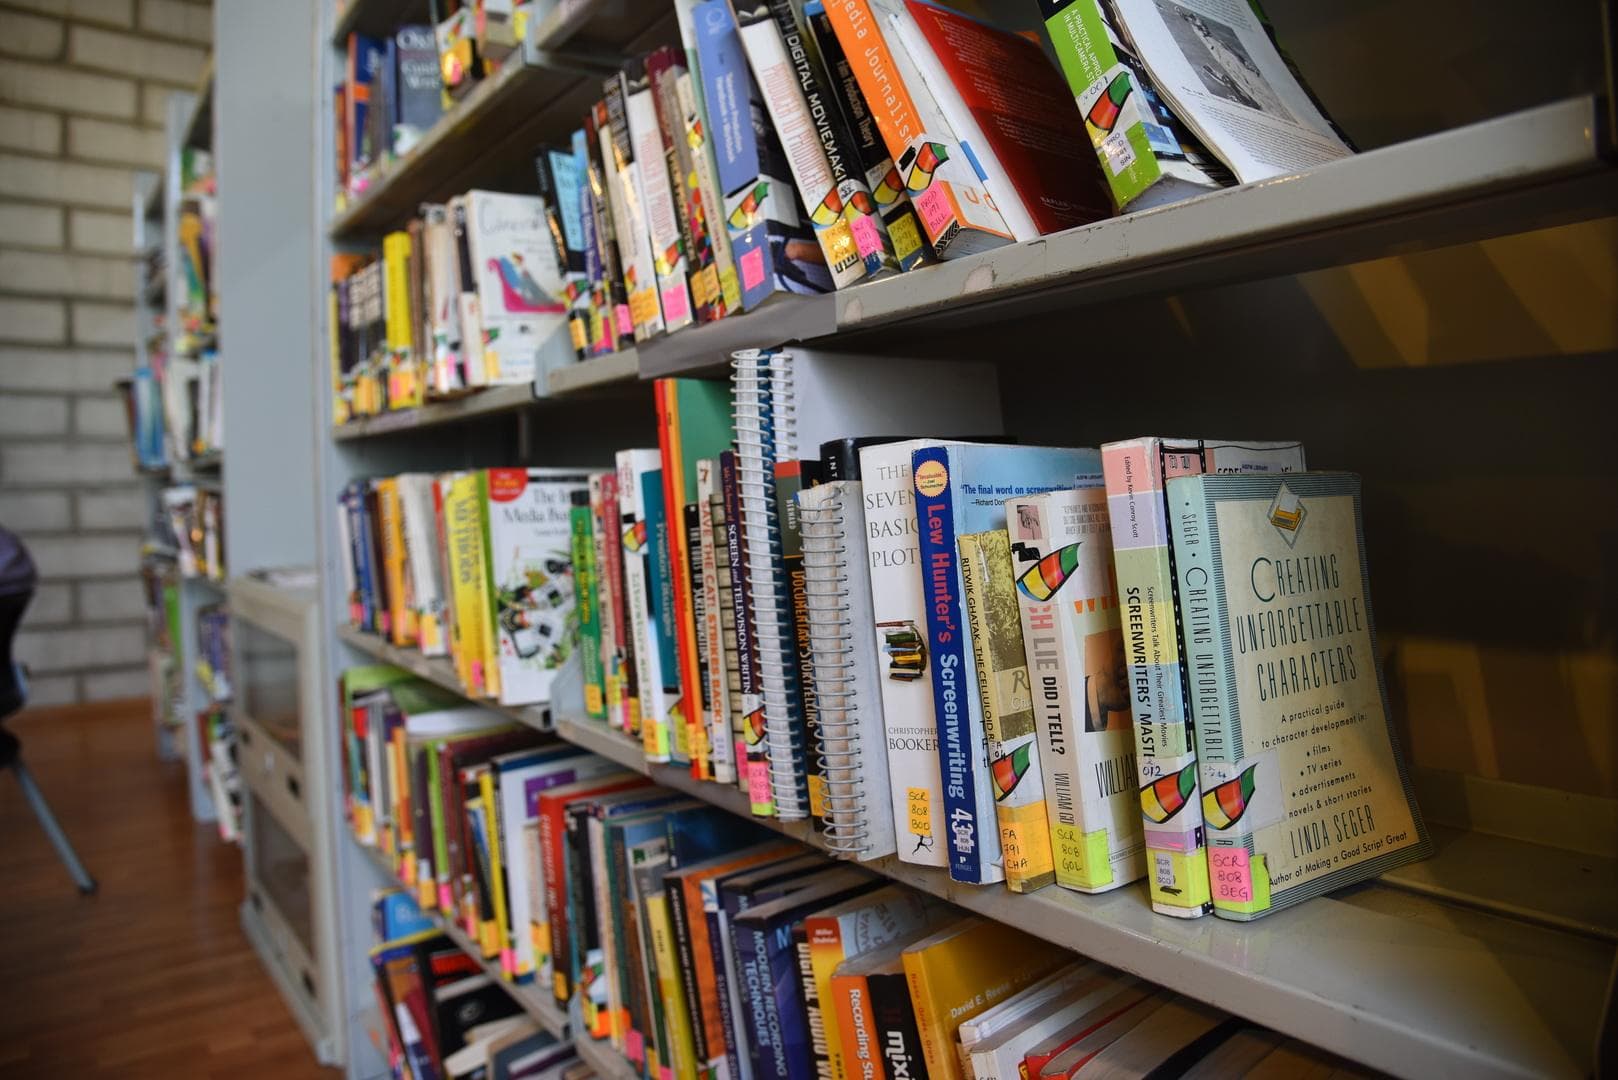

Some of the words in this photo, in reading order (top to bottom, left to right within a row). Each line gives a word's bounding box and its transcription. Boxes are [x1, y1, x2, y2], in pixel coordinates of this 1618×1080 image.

[1063, 14, 1070, 23] IN
[1075, 14, 1092, 51] PRACTICAL
[787, 35, 817, 91] DIGITAL
[857, 116, 875, 148] Theory
[877, 464, 909, 481] THE
[1122, 455, 1133, 474] Edited
[978, 484, 994, 495] final
[996, 484, 1013, 494] word
[1125, 483, 1134, 500] Kevin
[700, 500, 712, 536] SAVE
[926, 504, 946, 546] Lew
[1126, 500, 1137, 523] Conroy
[1130, 523, 1138, 538] Scott
[1182, 512, 1200, 546] SEGER
[703, 544, 714, 569] THE
[704, 576, 716, 608] CAT!
[728, 524, 738, 566] SCREEN
[734, 585, 747, 650] TELEVISION
[962, 558, 974, 594] RITWIK
[1251, 554, 1340, 602] CREATING
[931, 552, 956, 644] Hunter's
[1186, 567, 1212, 644] CREATING
[1236, 597, 1362, 654] UNFORGETTABLE
[706, 614, 720, 678] STRIKES
[976, 647, 985, 668] THE
[1033, 638, 1058, 670] LIE
[1147, 586, 1156, 632] Screenwriters
[1158, 692, 1166, 720] Greatest
[1042, 676, 1058, 700] DID
[1257, 645, 1358, 702] CHARACTERS
[712, 681, 722, 724] BACK!
[979, 671, 994, 730] CELLULOID
[1200, 654, 1225, 762] UNFORGETTABLE
[1281, 714, 1287, 724] A
[1289, 705, 1323, 724] practical
[1324, 700, 1345, 716] guide
[888, 726, 938, 736] CHRISTOPHER
[940, 653, 966, 800] Screenwriting
[1048, 713, 1065, 756] TELL?
[1262, 740, 1270, 748] to
[1272, 728, 1309, 746] character
[1310, 718, 1354, 737] development
[888, 738, 940, 752] BOOKER
[1312, 745, 1332, 756] films
[1306, 764, 1317, 774] TV
[1320, 758, 1342, 772] series
[908, 792, 927, 802] SCR
[1054, 773, 1071, 811] WILLIAM
[1298, 771, 1356, 796] advertisements
[1288, 803, 1314, 818] novels
[1316, 800, 1322, 810] &
[1324, 794, 1344, 808] short
[1346, 785, 1372, 801] stories
[1002, 828, 1017, 840] FA
[1057, 829, 1076, 842] SCR
[1290, 823, 1330, 860] LINDA
[1335, 804, 1376, 843] SEGER
[1006, 858, 1028, 870] CHA
[1062, 846, 1080, 858] 808
[1268, 872, 1293, 888] Author
[1295, 866, 1303, 878] of
[1305, 858, 1332, 877] Making
[1341, 846, 1360, 861] Good
[1362, 839, 1384, 856] Script
[1386, 832, 1408, 847] Great
[797, 942, 818, 1002] DIGITAL
[746, 960, 770, 1046] TECHNIQUES
[753, 931, 772, 992] MODERN
[765, 994, 787, 1076] RECORDING
[951, 998, 975, 1018] David
[807, 1006, 829, 1054] AUDIO
[850, 989, 869, 1059] Recording
